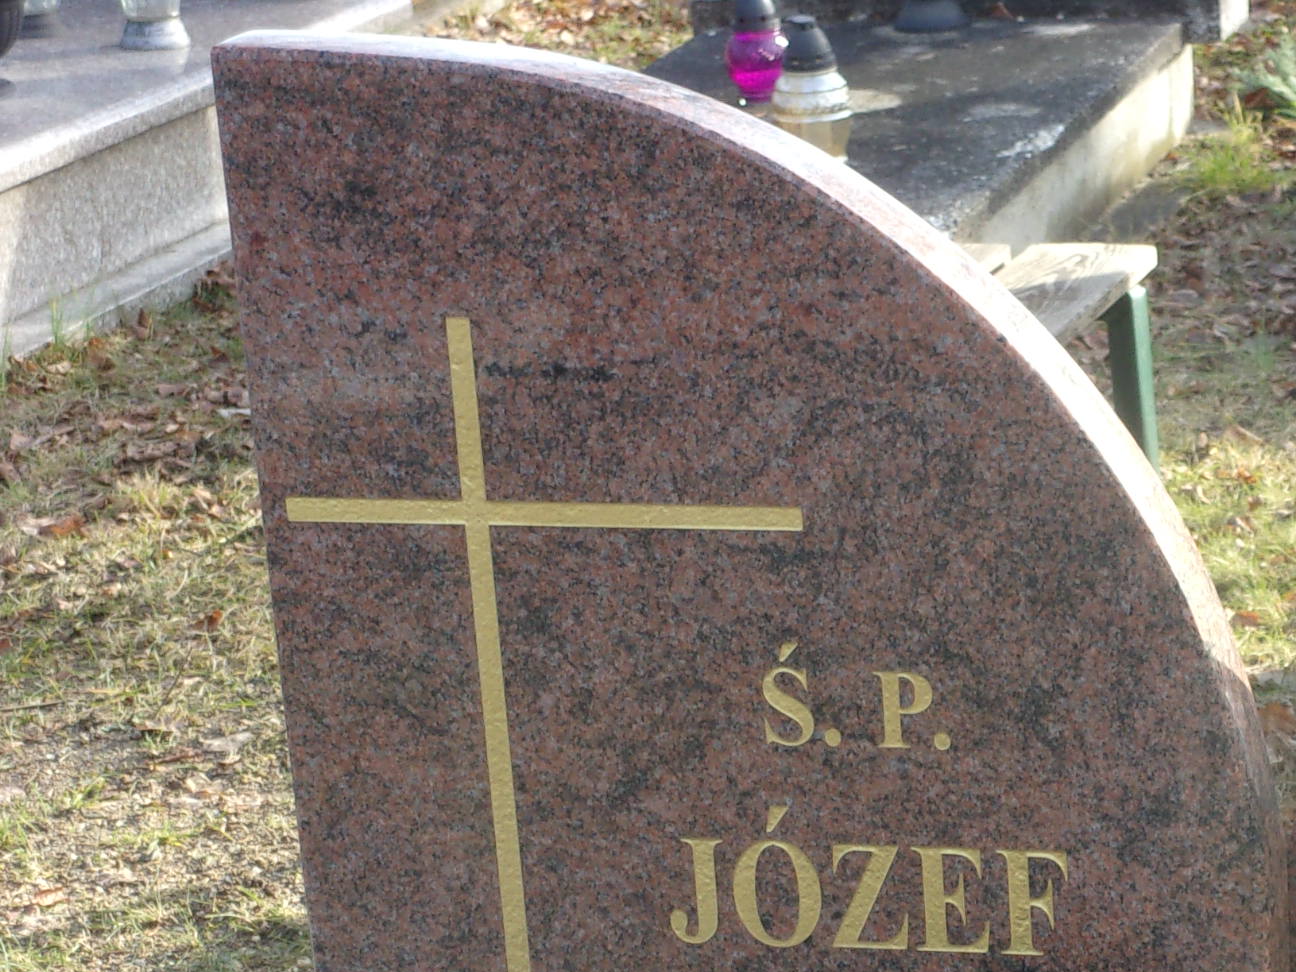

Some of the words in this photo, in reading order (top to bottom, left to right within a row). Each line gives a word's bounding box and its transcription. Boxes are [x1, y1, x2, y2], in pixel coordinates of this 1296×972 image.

[761, 643, 843, 749] Ś.
[872, 670, 952, 752] P.
[669, 806, 1069, 956] JÓZEF
